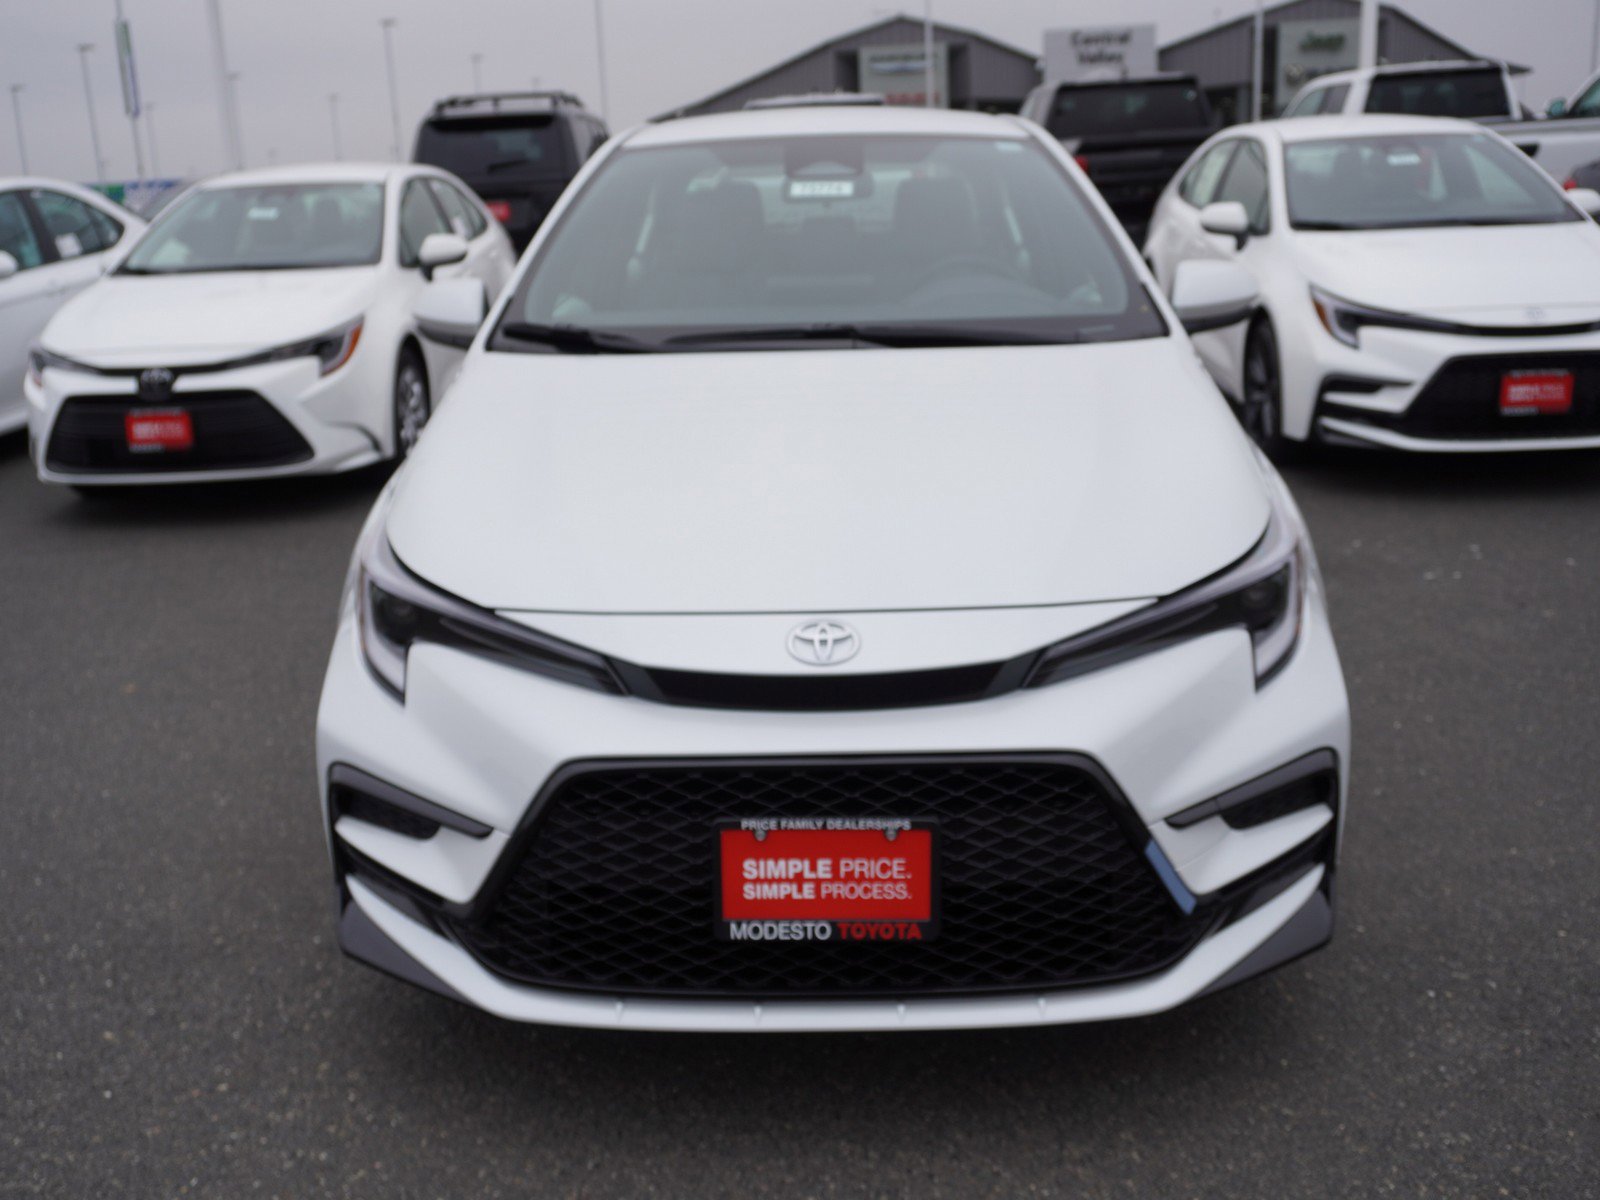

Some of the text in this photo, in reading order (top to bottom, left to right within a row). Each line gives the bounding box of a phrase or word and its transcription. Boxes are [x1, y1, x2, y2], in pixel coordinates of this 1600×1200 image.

[741, 819, 912, 830] PRICE FAMILY DEALERSHIPS
[743, 859, 911, 879] SIMPLE PRICE.
[743, 882, 912, 900] SIMPLE PROCESS.
[730, 921, 922, 941] MODESTO TOYOTA
